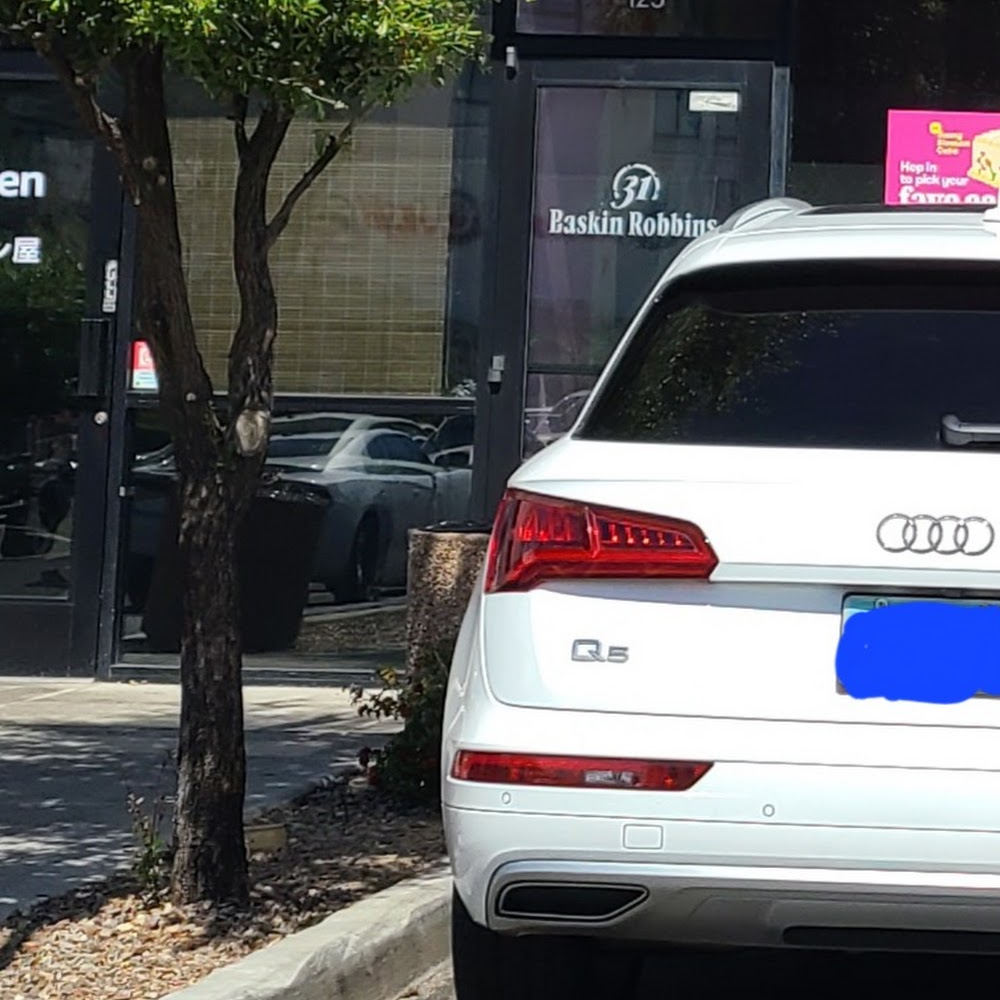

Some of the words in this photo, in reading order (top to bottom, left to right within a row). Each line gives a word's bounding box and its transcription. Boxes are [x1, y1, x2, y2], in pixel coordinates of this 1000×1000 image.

[900, 161, 923, 174] Hop
[900, 174, 913, 184] to
[915, 175, 940, 186] pick
[942, 178, 969, 187] your
[610, 175, 653, 209] 31
[549, 209, 624, 235] Baskin
[628, 211, 718, 238] Robbins
[571, 638, 629, 664] Q5
